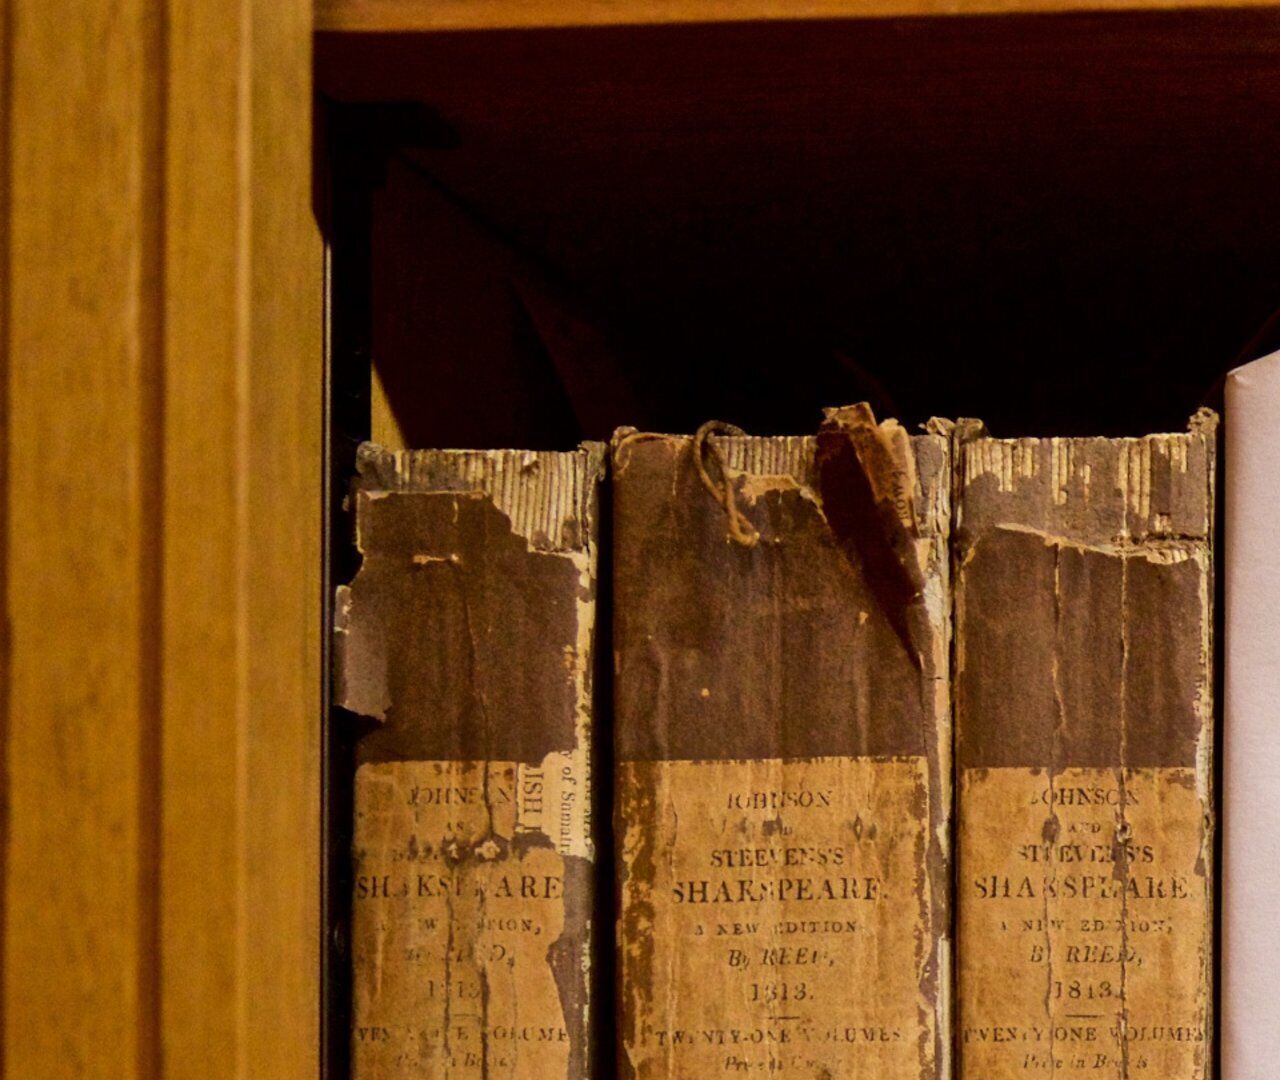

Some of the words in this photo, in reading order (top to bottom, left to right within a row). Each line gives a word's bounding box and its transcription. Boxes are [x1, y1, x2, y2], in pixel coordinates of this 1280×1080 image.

[1017, 845, 1155, 864] STEVES'S
[356, 874, 564, 900] SHKSARE
[427, 979, 482, 999] 113
[654, 1029, 792, 1045] TWNTY-ONE
